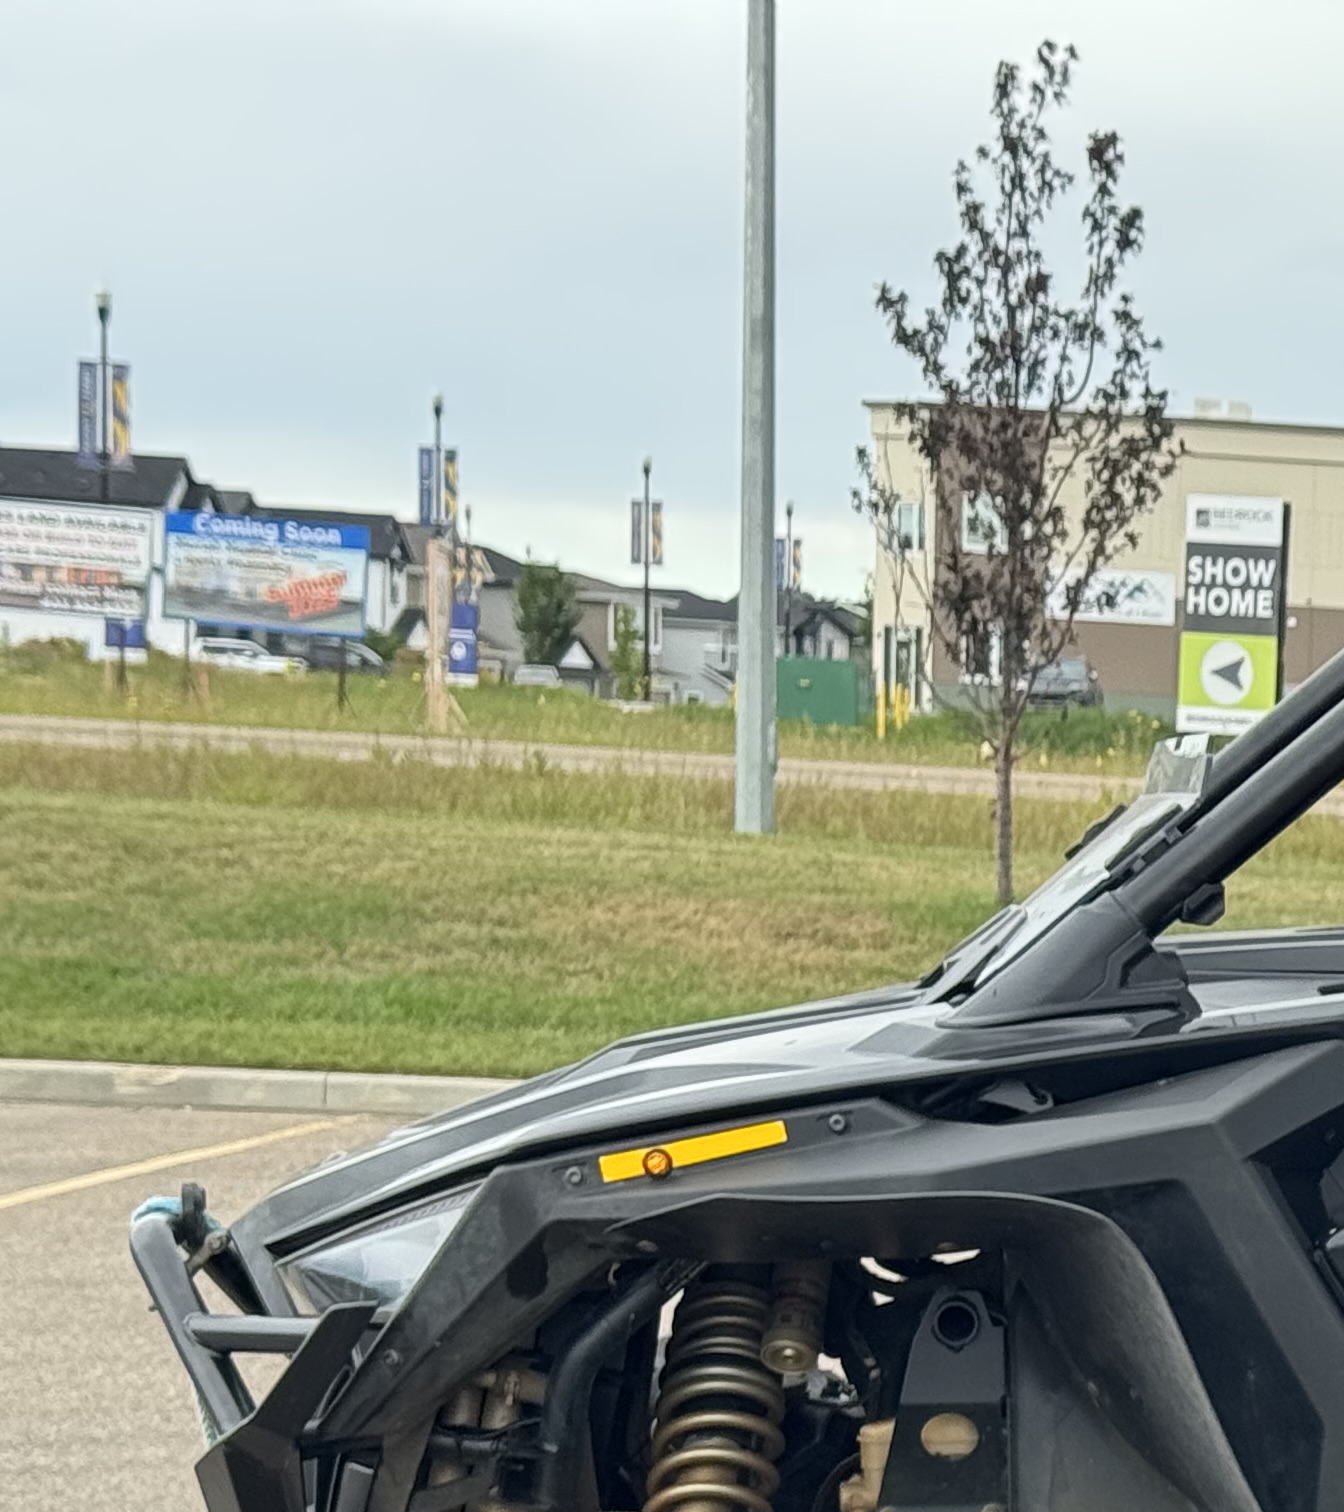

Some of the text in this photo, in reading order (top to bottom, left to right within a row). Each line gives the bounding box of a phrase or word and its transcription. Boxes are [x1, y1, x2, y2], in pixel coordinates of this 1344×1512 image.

[195, 513, 342, 547] Coming Soon
[1188, 555, 1276, 588] SHOW
[1187, 586, 1274, 619] HOME
